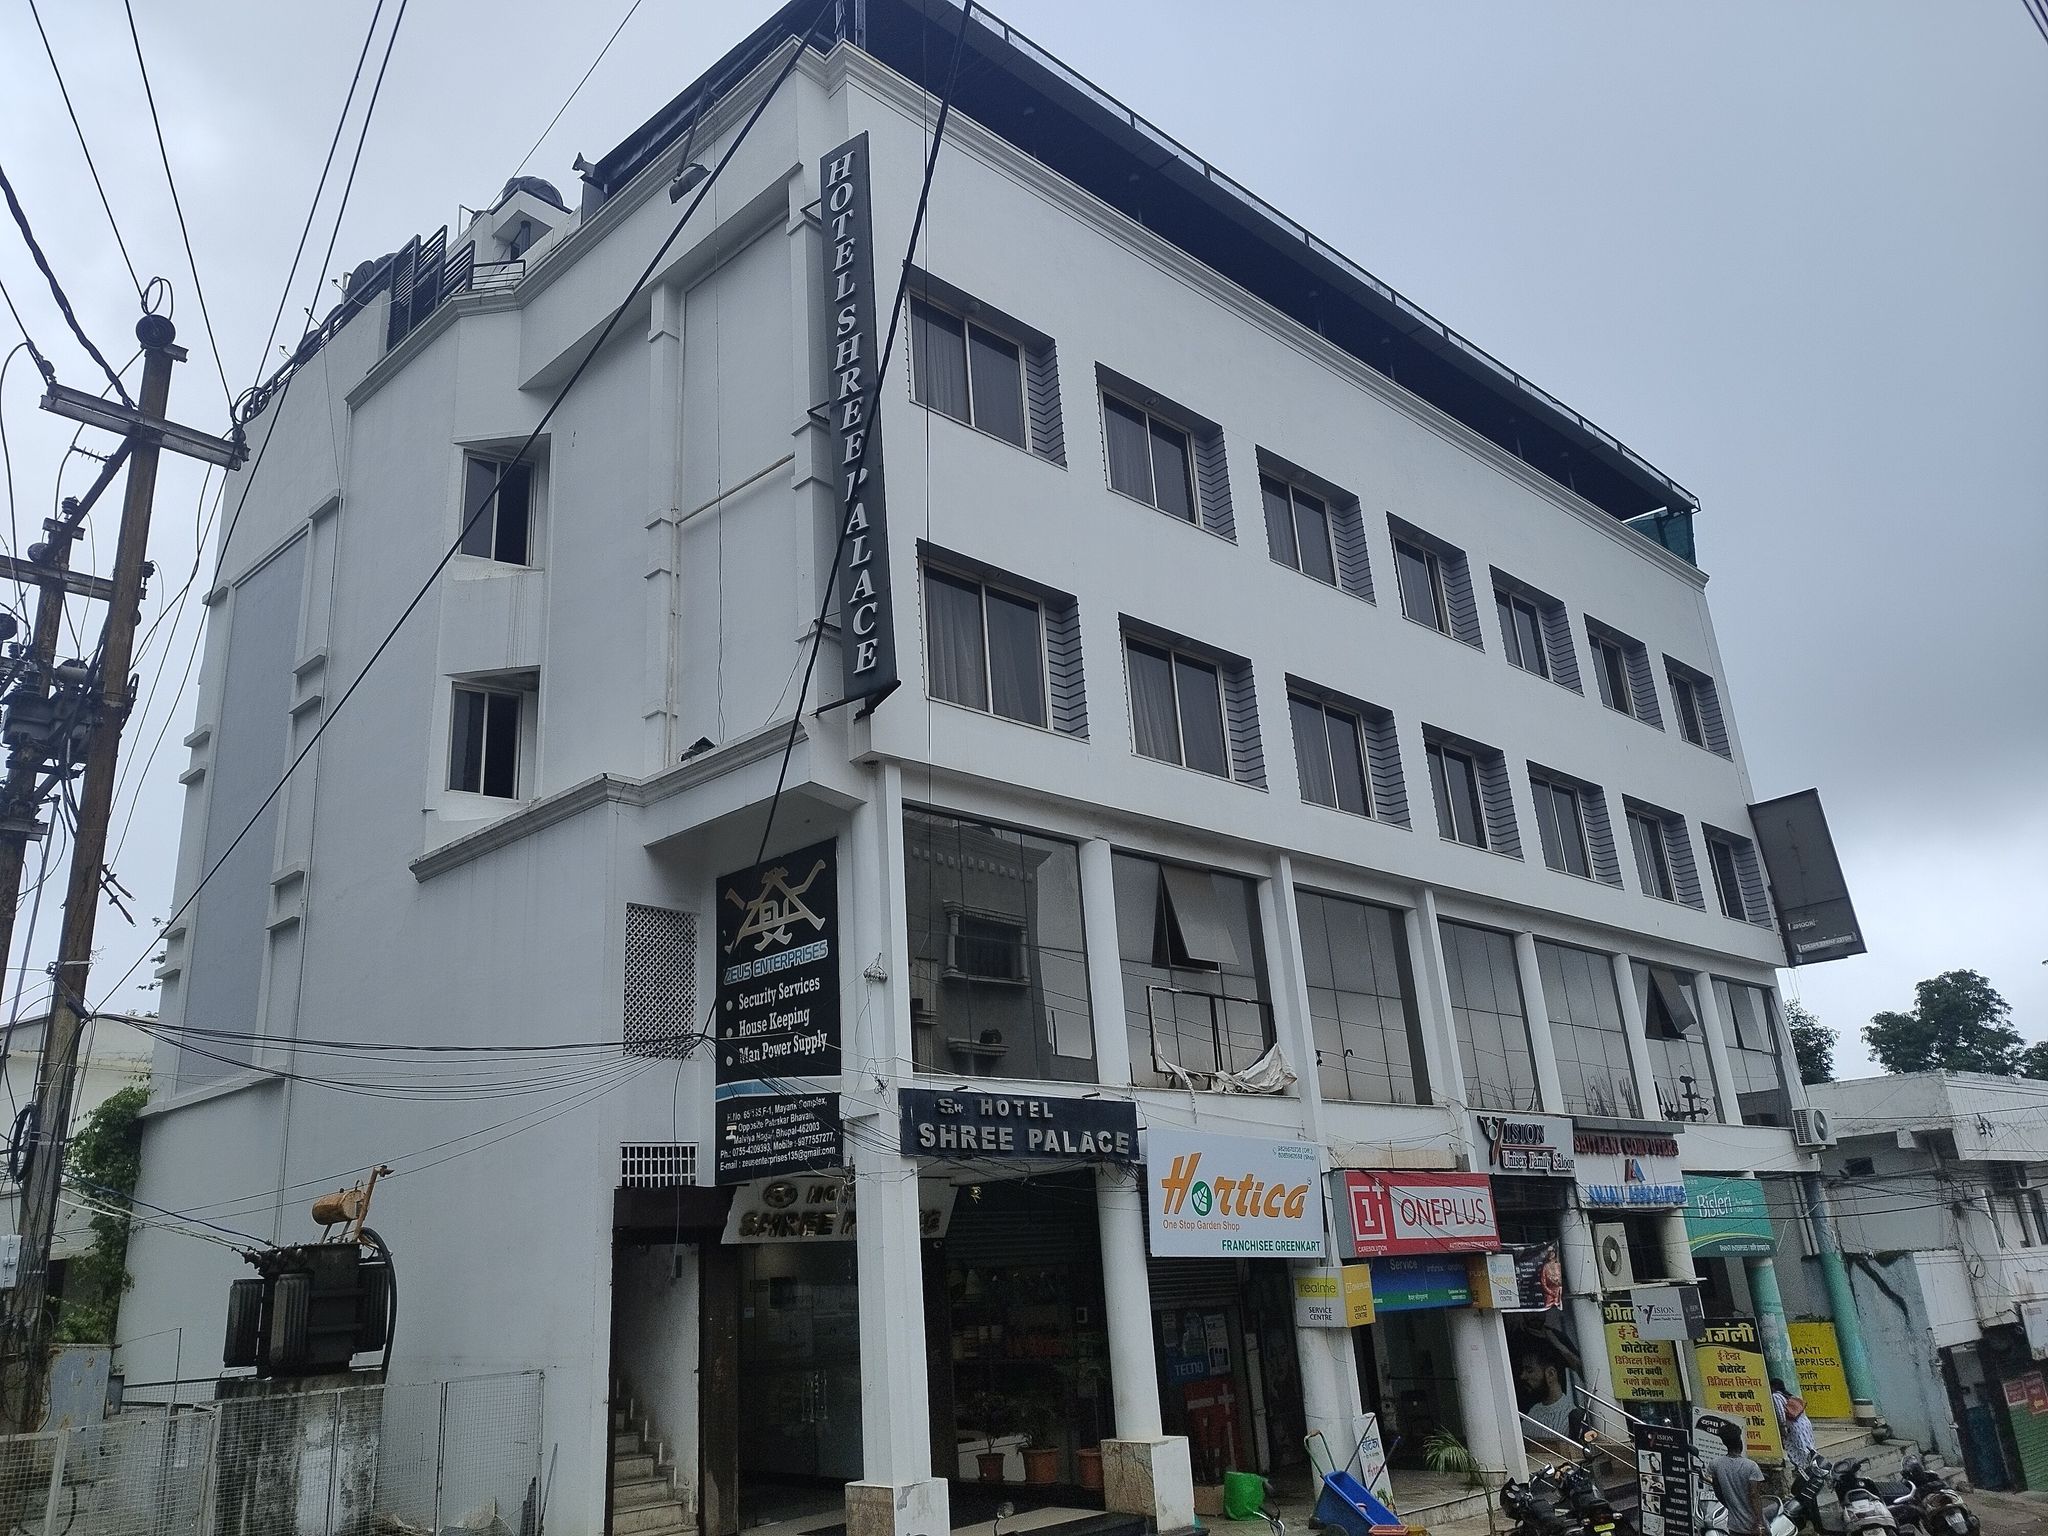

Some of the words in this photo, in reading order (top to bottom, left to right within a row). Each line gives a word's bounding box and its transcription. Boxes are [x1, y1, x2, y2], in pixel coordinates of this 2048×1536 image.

[826, 150, 855, 302] HOTEL
[833, 303, 864, 466] SHREE
[844, 467, 880, 675] PALACE
[724, 961, 752, 985] ZEUS
[753, 939, 829, 978] ENTERPRISES
[739, 986, 777, 1010] Security
[778, 976, 821, 1001] Services
[739, 1019, 768, 1037] House
[769, 1006, 810, 1031] Keeping
[739, 1046, 761, 1064] Man
[762, 1040, 792, 1060] Power
[793, 1029, 828, 1056] Supply
[981, 1099, 1054, 1118] HOTEL
[918, 1122, 1015, 1151] SHREE
[1029, 1128, 1130, 1155] PALACE
[1622, 1138, 1680, 1157] COMPUTERS
[1502, 1151, 1527, 1169] Unisex
[1528, 1151, 1551, 1176] Family
[1552, 1152, 1575, 1171] Saloon
[1161, 1152, 1311, 1219] Hortica
[1400, 1198, 1487, 1227] ONEPLUS
[1697, 1190, 1733, 1218] Bisleri
[1162, 1219, 1178, 1230] One
[1179, 1220, 1196, 1231] Stop
[1197, 1221, 1222, 1231] Garden
[1222, 1221, 1240, 1232] Shop
[1221, 1239, 1274, 1251] FRANCHISEE
[1275, 1240, 1321, 1252] GREENKART
[1389, 1258, 1418, 1271] Service
[1300, 1281, 1336, 1294] realme
[1308, 1306, 1333, 1314] SERVICE
[1603, 1303, 1635, 1321] शीत
[1621, 1341, 1660, 1354] फोटोस्टेट
[1792, 1346, 1821, 1355] HANTI
[1174, 1361, 1204, 1377] TECNO
[1717, 1364, 1747, 1374] फोटोस्टेट
[1794, 1357, 1836, 1367] ERPRISES
[1626, 1367, 1644, 1376] कलर
[1707, 1376, 1735, 1387] डिजिटल
[1719, 1391, 1737, 1399] कलर
